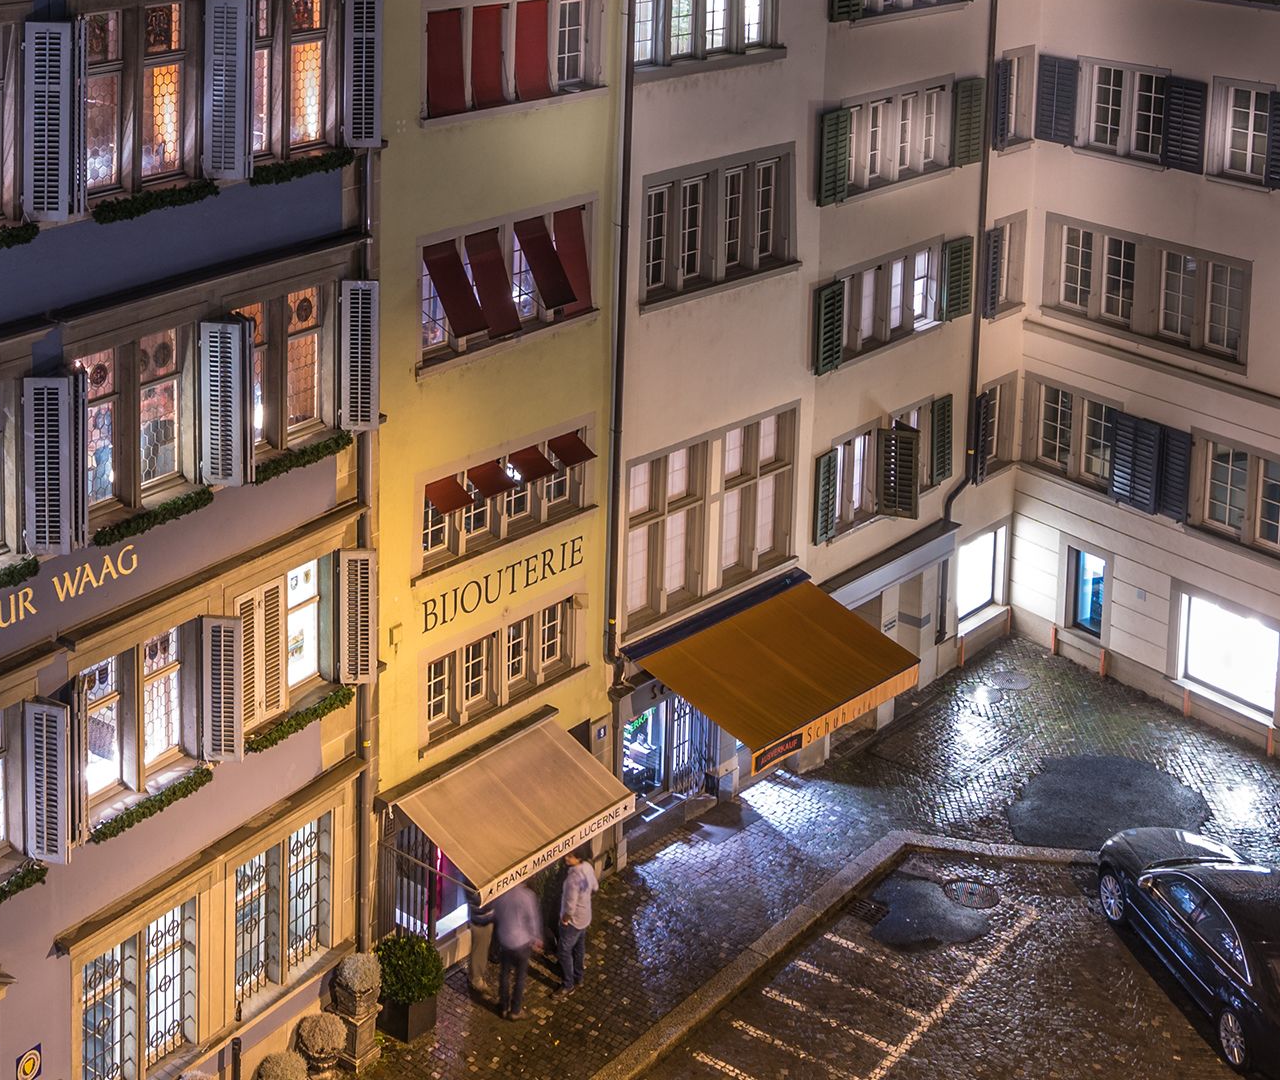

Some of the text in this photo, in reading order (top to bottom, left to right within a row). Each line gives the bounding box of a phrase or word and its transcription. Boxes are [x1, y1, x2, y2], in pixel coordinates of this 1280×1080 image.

[51, 544, 140, 602] WAAG
[422, 536, 583, 634] BIJOUTERIE
[760, 738, 799, 765] AUSVERKAUF
[807, 709, 847, 743] Schuh
[496, 808, 621, 892] FRANZ MARFURT LUCERNE
